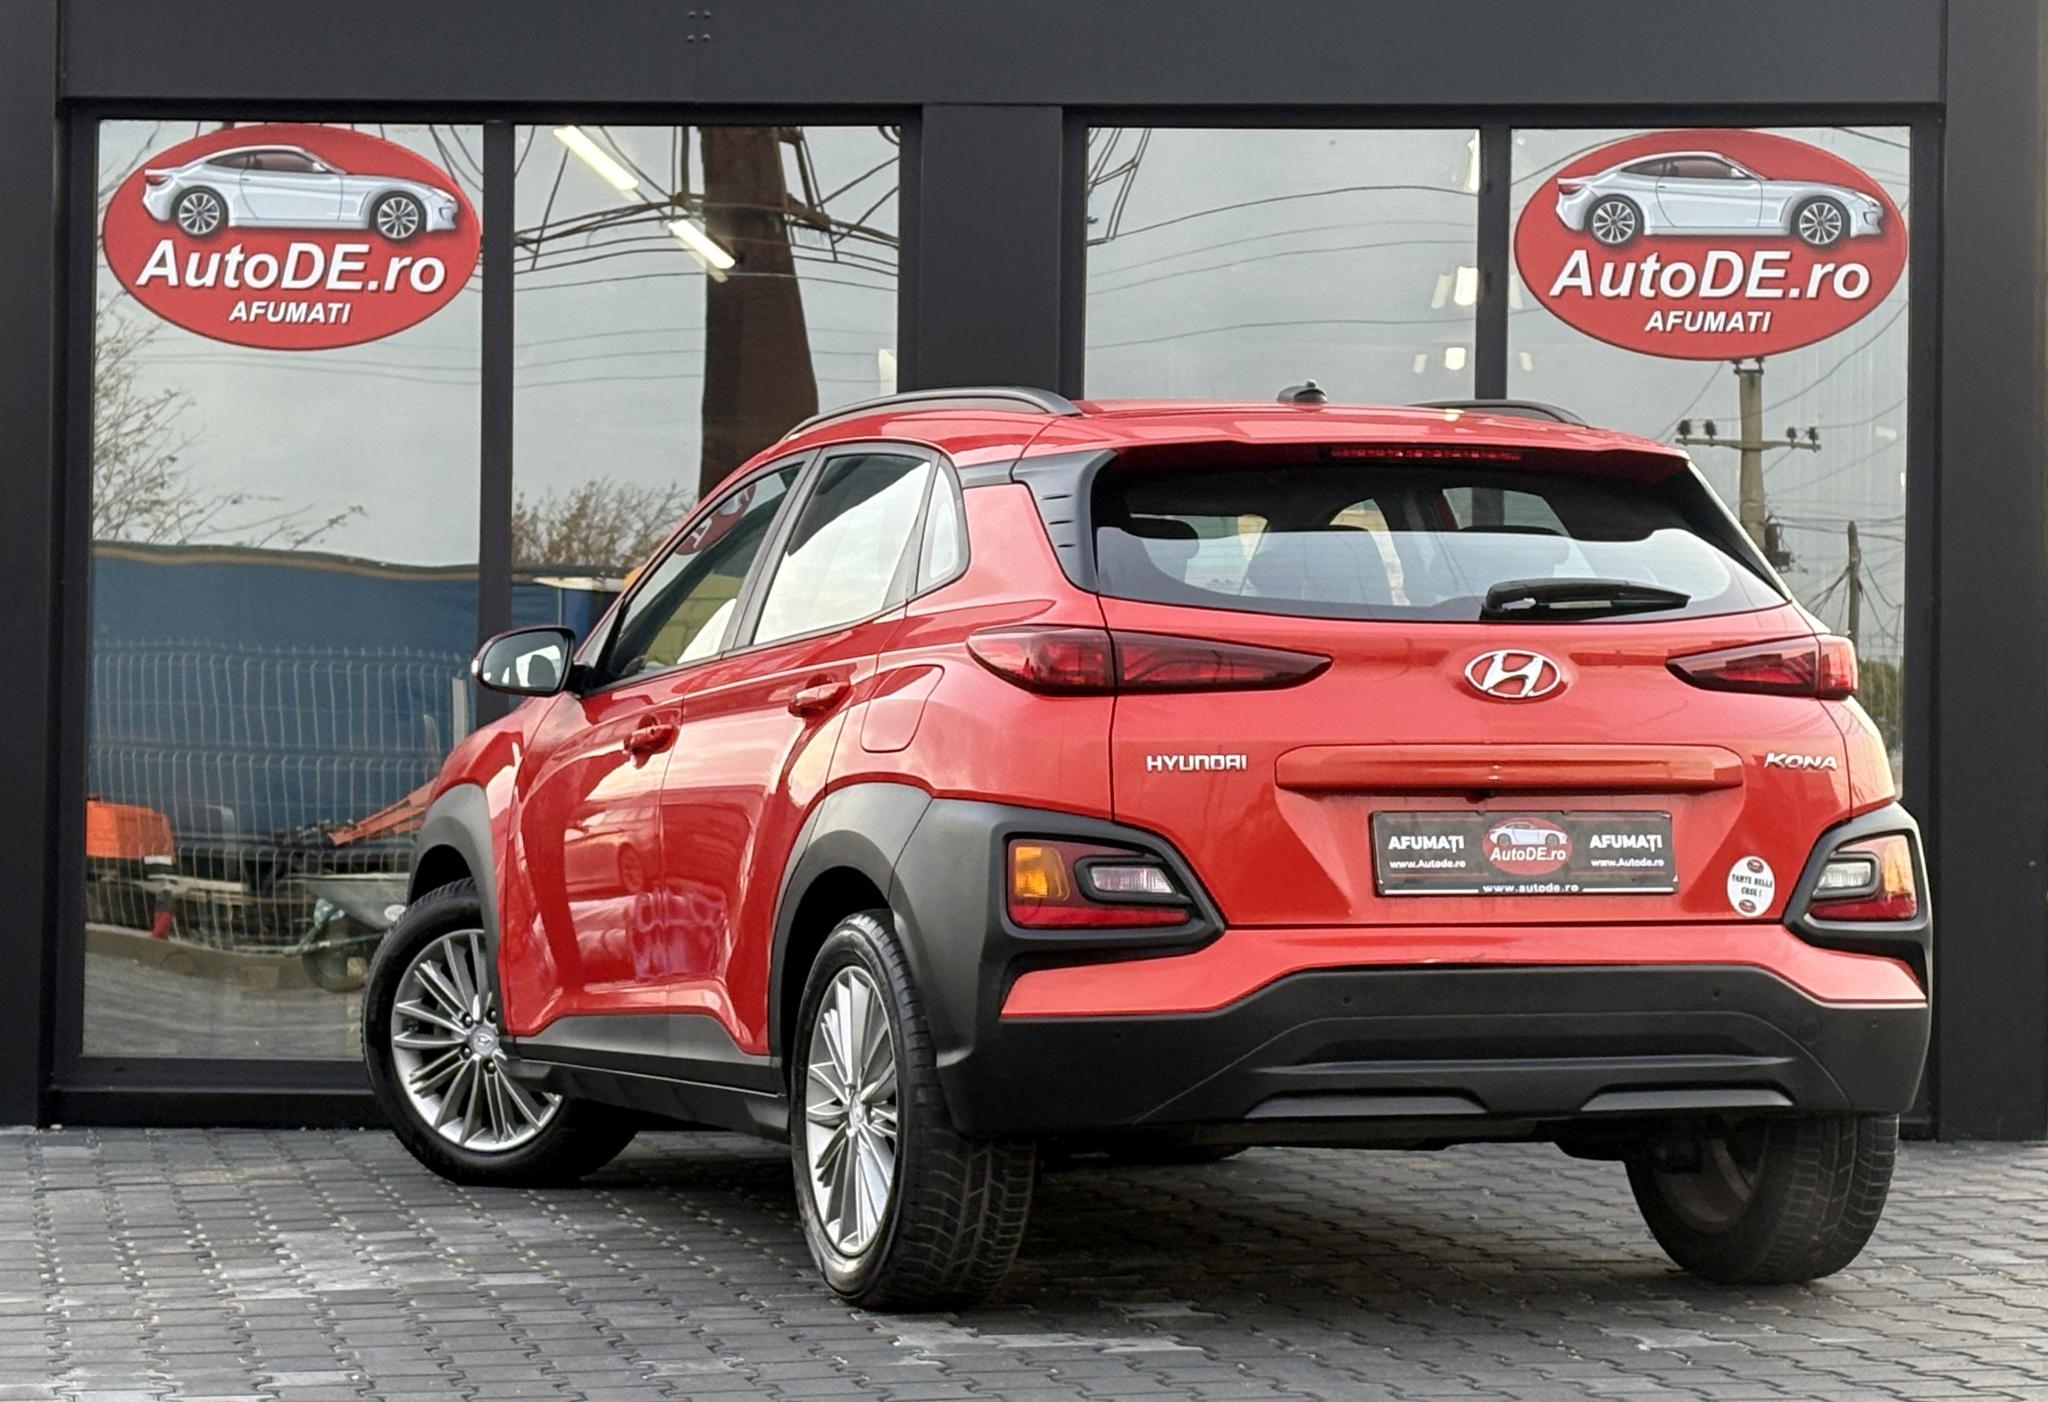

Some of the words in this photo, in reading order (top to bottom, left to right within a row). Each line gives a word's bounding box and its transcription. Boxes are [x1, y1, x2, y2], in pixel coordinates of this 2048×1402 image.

[136, 239, 446, 293] AutoDE.ro
[1549, 249, 1871, 299] AutoDE.ro
[228, 301, 352, 324] AFUMATI
[1644, 311, 1773, 332] AFUMATI
[1146, 754, 1248, 772] HYUNDAI
[1763, 752, 1838, 770] KONA
[1489, 846, 1567, 862] AutoDE.ro
[1389, 858, 1467, 869] www.Autode.ro
[1482, 882, 1580, 893] www.autode.ro
